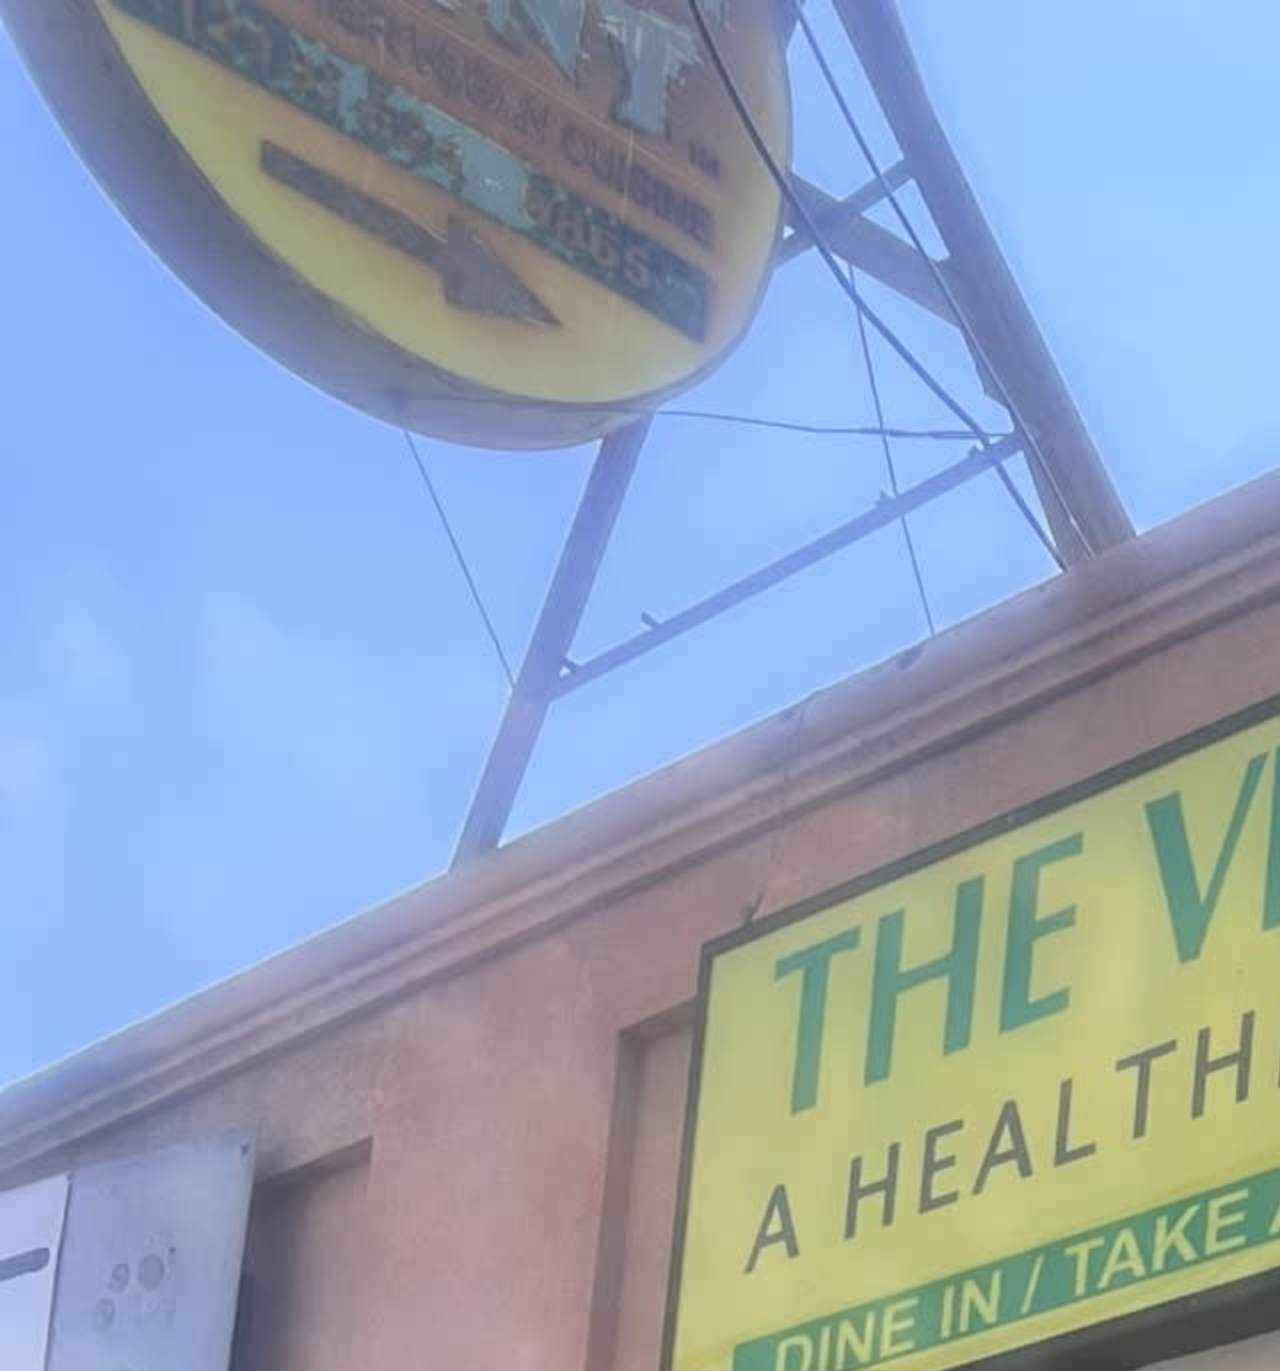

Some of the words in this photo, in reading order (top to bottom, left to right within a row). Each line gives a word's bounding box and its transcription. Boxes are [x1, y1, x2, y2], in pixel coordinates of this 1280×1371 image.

[774, 831, 1083, 1116] THE
[743, 1184, 799, 1275] A
[938, 1270, 1003, 1337] IN
[1065, 1188, 1250, 1299] TAKE
